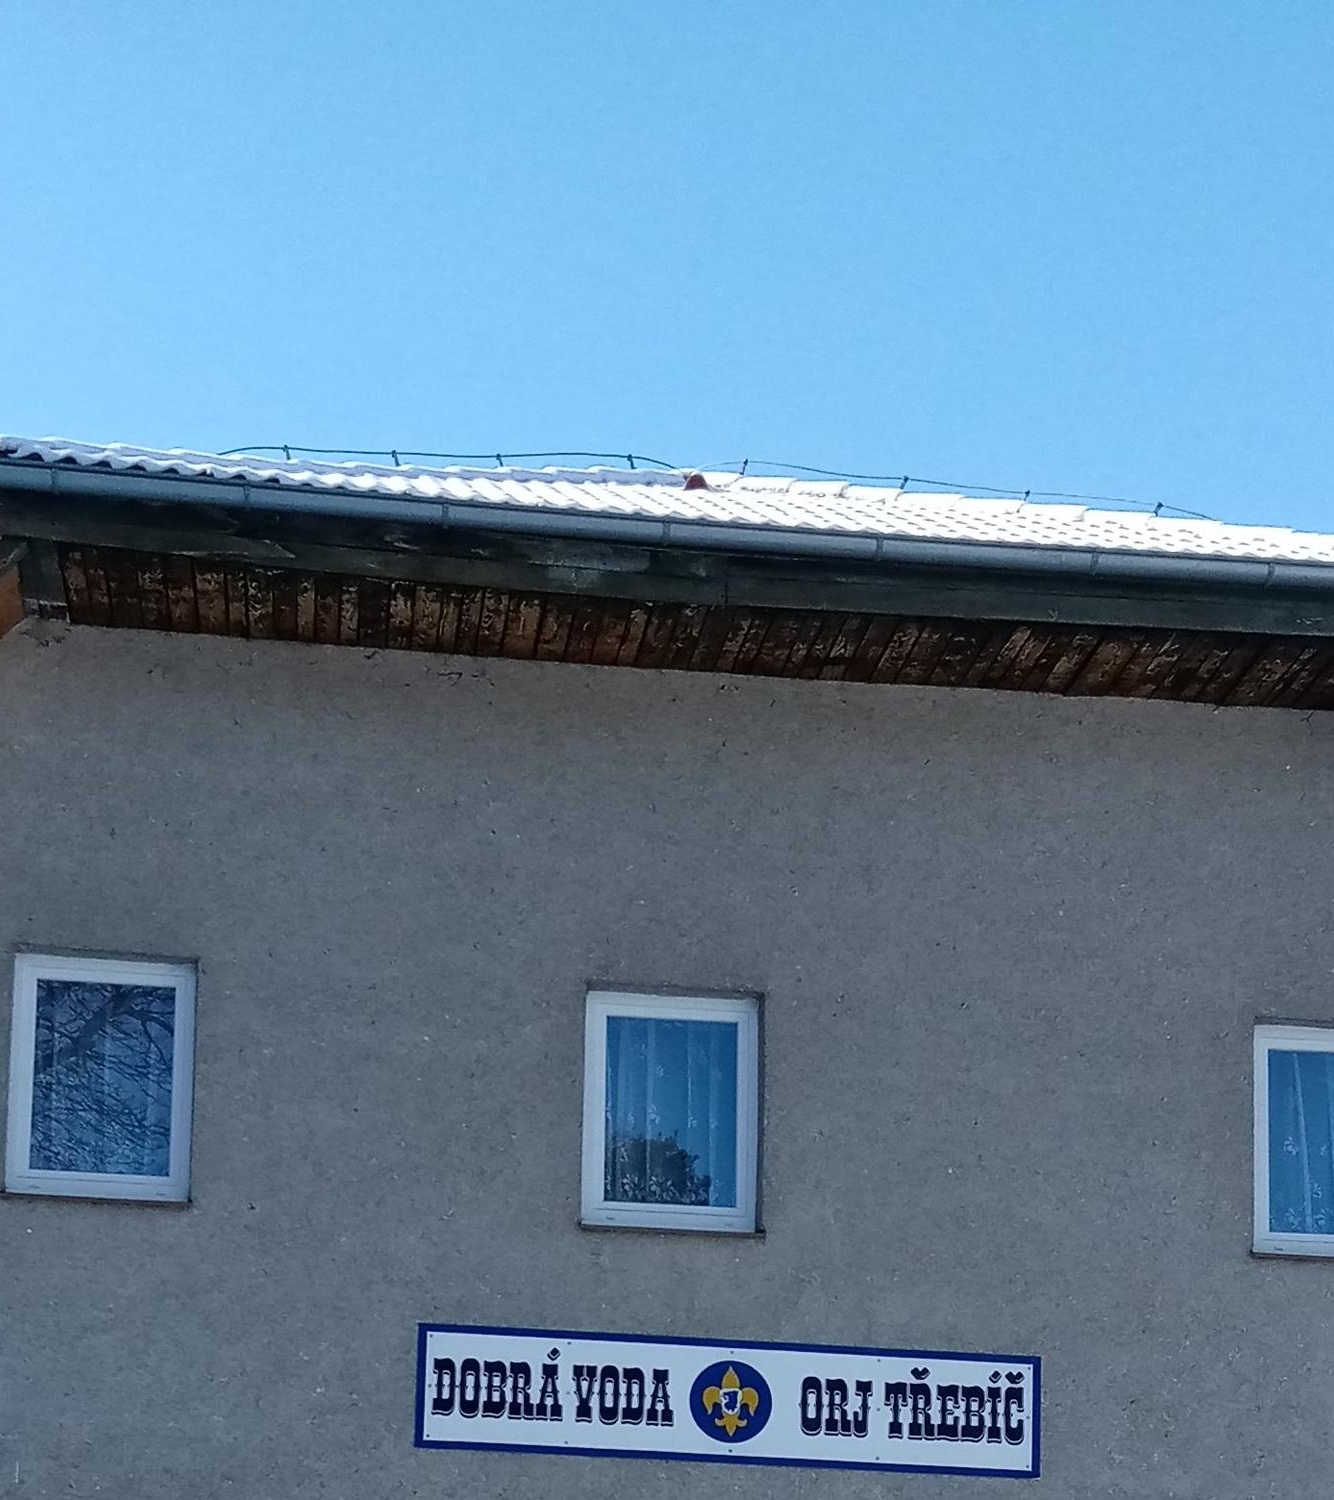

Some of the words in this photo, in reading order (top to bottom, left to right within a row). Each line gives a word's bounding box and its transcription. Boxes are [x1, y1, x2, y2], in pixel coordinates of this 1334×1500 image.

[431, 1347, 563, 1422] DOBRÁ
[572, 1364, 674, 1427] VODA
[799, 1376, 873, 1438] ORJ
[884, 1367, 1025, 1446] TŘEBÍČ
